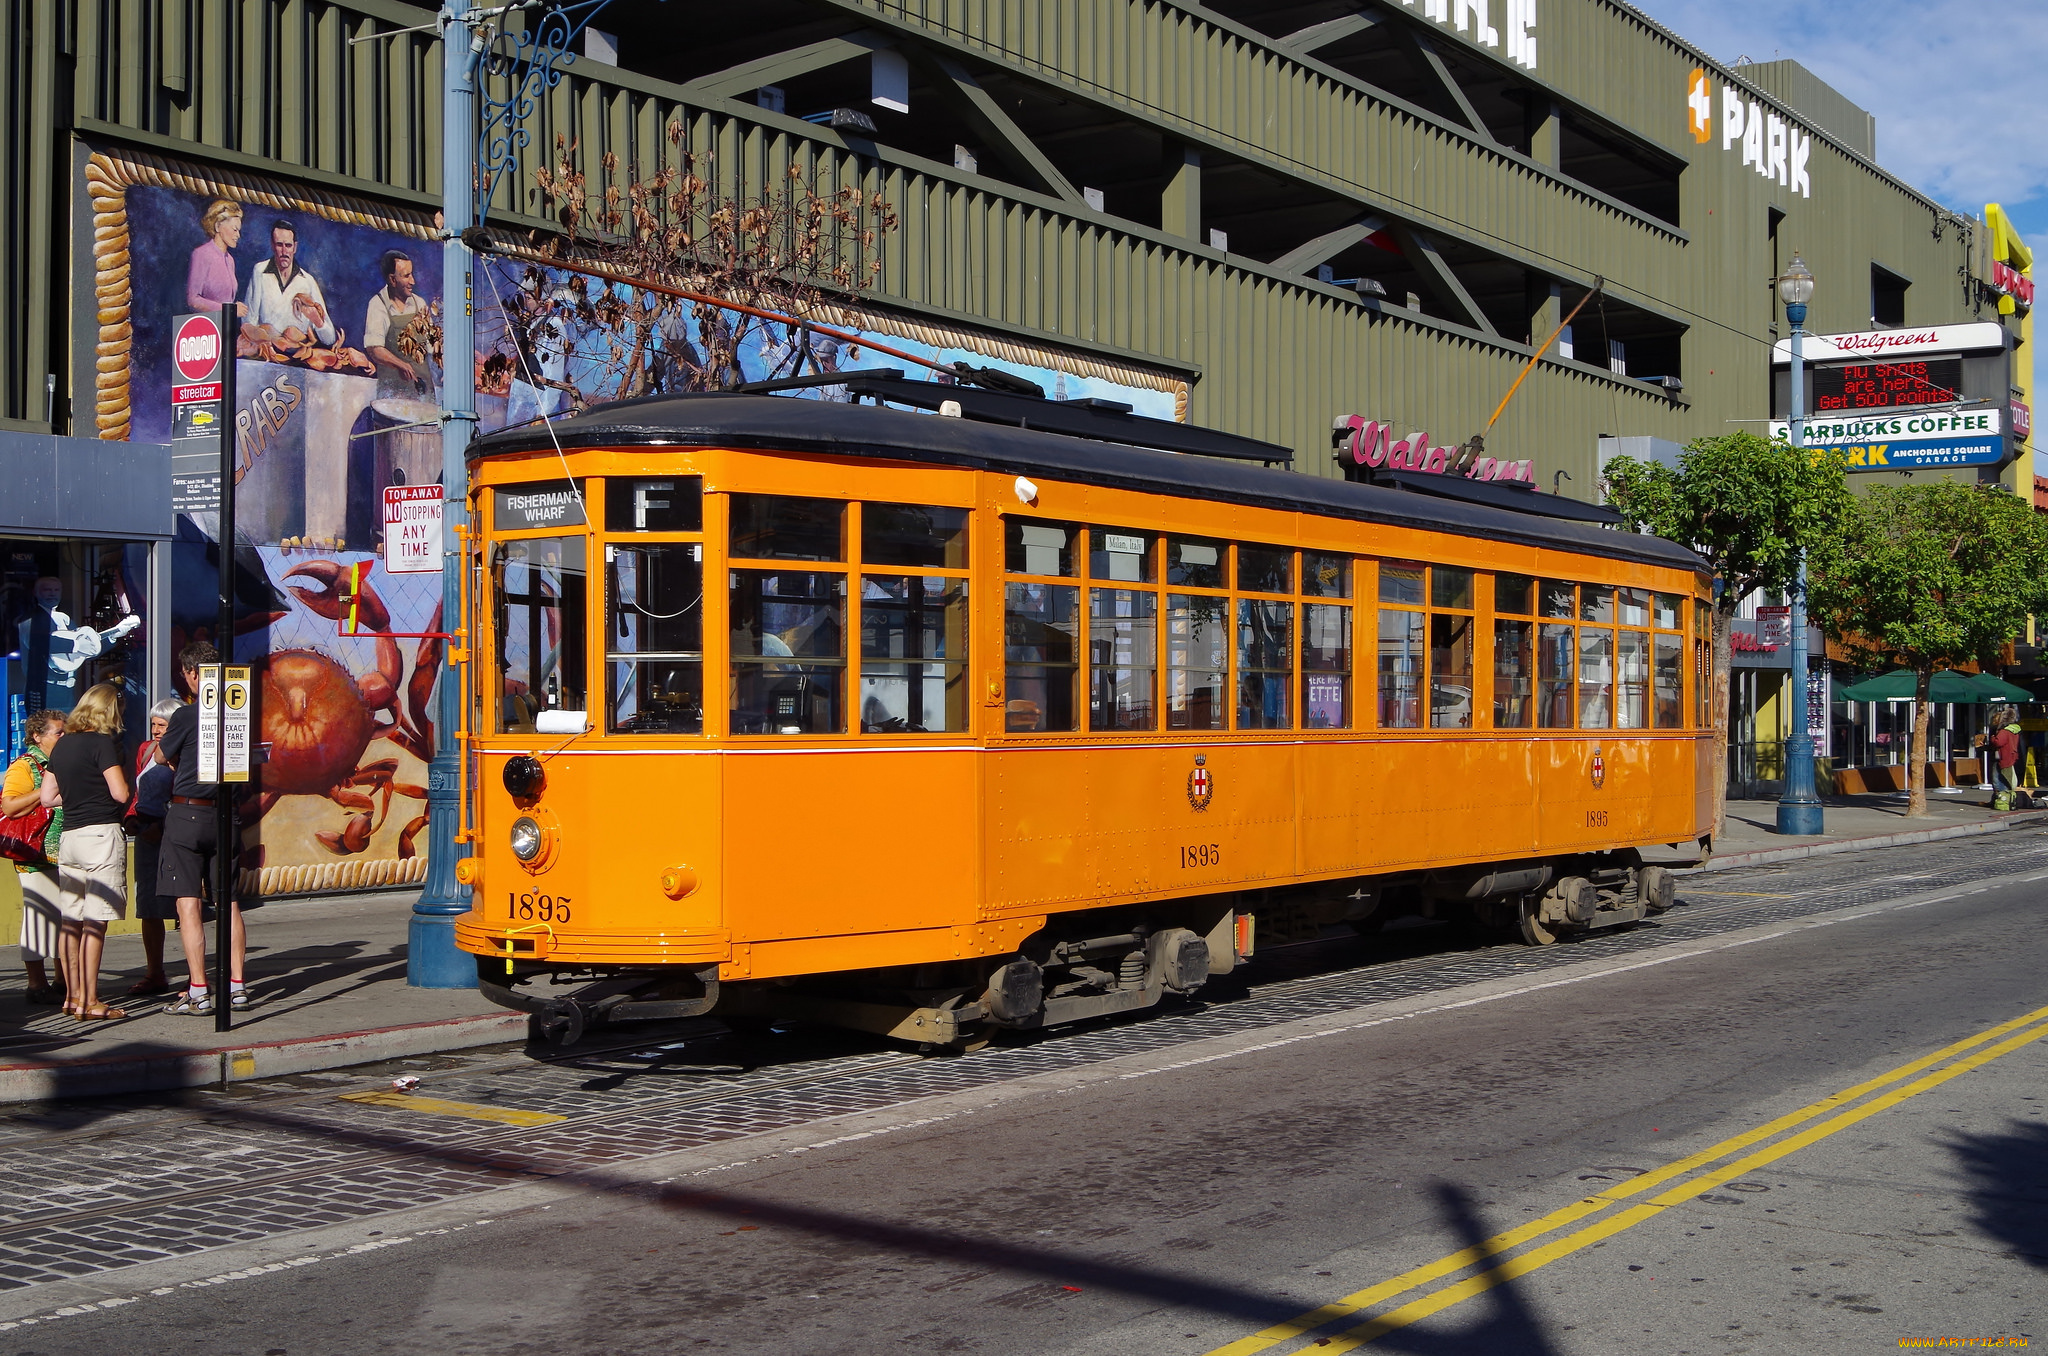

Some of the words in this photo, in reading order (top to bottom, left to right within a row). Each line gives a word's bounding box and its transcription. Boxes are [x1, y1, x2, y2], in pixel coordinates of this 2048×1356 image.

[1722, 86, 1810, 198] PARK
[1835, 331, 1939, 353] Walgreens
[1844, 366, 1868, 379] Flu
[1875, 362, 1927, 377] Shots
[179, 386, 215, 399] streetcar
[1845, 380, 1875, 393] are
[1882, 374, 1929, 390] here!
[1819, 395, 1848, 409] Get
[1855, 392, 1888, 407] 500
[1895, 387, 1953, 406] points!
[178, 406, 184, 421] F
[2010, 405, 2029, 428] OTLE
[235, 374, 302, 486] RABS
[1778, 420, 1901, 440] SARBUCKS
[1907, 415, 1989, 433] COFFEE
[1810, 444, 1889, 467] PRK
[1893, 448, 1951, 457] ANCHORAGE
[1954, 446, 1992, 454] SQUARE
[1916, 455, 1967, 463] GARAGE
[388, 488, 439, 500] TOW-AWAY
[508, 490, 582, 510] FISHERMAN'S
[386, 502, 401, 521] NO
[403, 504, 441, 520] STOPPING
[525, 506, 565, 521] WHARF
[635, 482, 675, 528] F
[402, 525, 427, 539] ANY
[400, 542, 429, 556] TIME
[206, 688, 214, 705] F
[231, 688, 241, 705] F
[225, 724, 246, 732] EXACT
[227, 732, 244, 741] FARE
[1585, 810, 1608, 828] 1895
[1181, 843, 1219, 869] 1895
[508, 892, 572, 924] 1895
